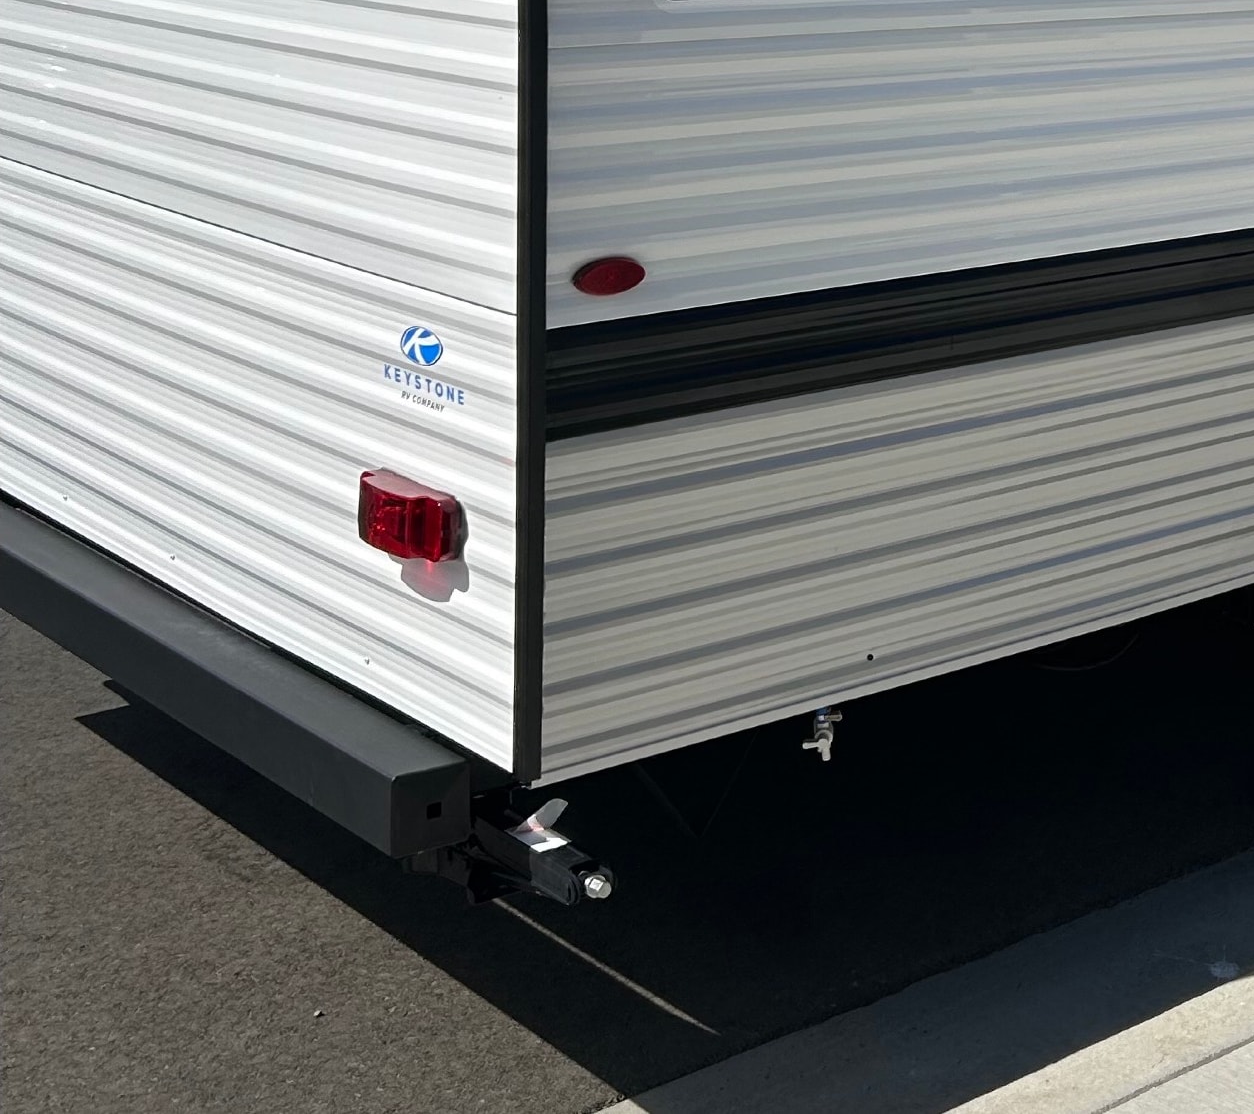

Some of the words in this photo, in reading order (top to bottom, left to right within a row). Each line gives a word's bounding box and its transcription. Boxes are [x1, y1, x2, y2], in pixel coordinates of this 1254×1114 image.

[384, 364, 465, 405] KEYSTONE
[401, 390, 411, 400] RV
[412, 394, 445, 412] COMPANY
